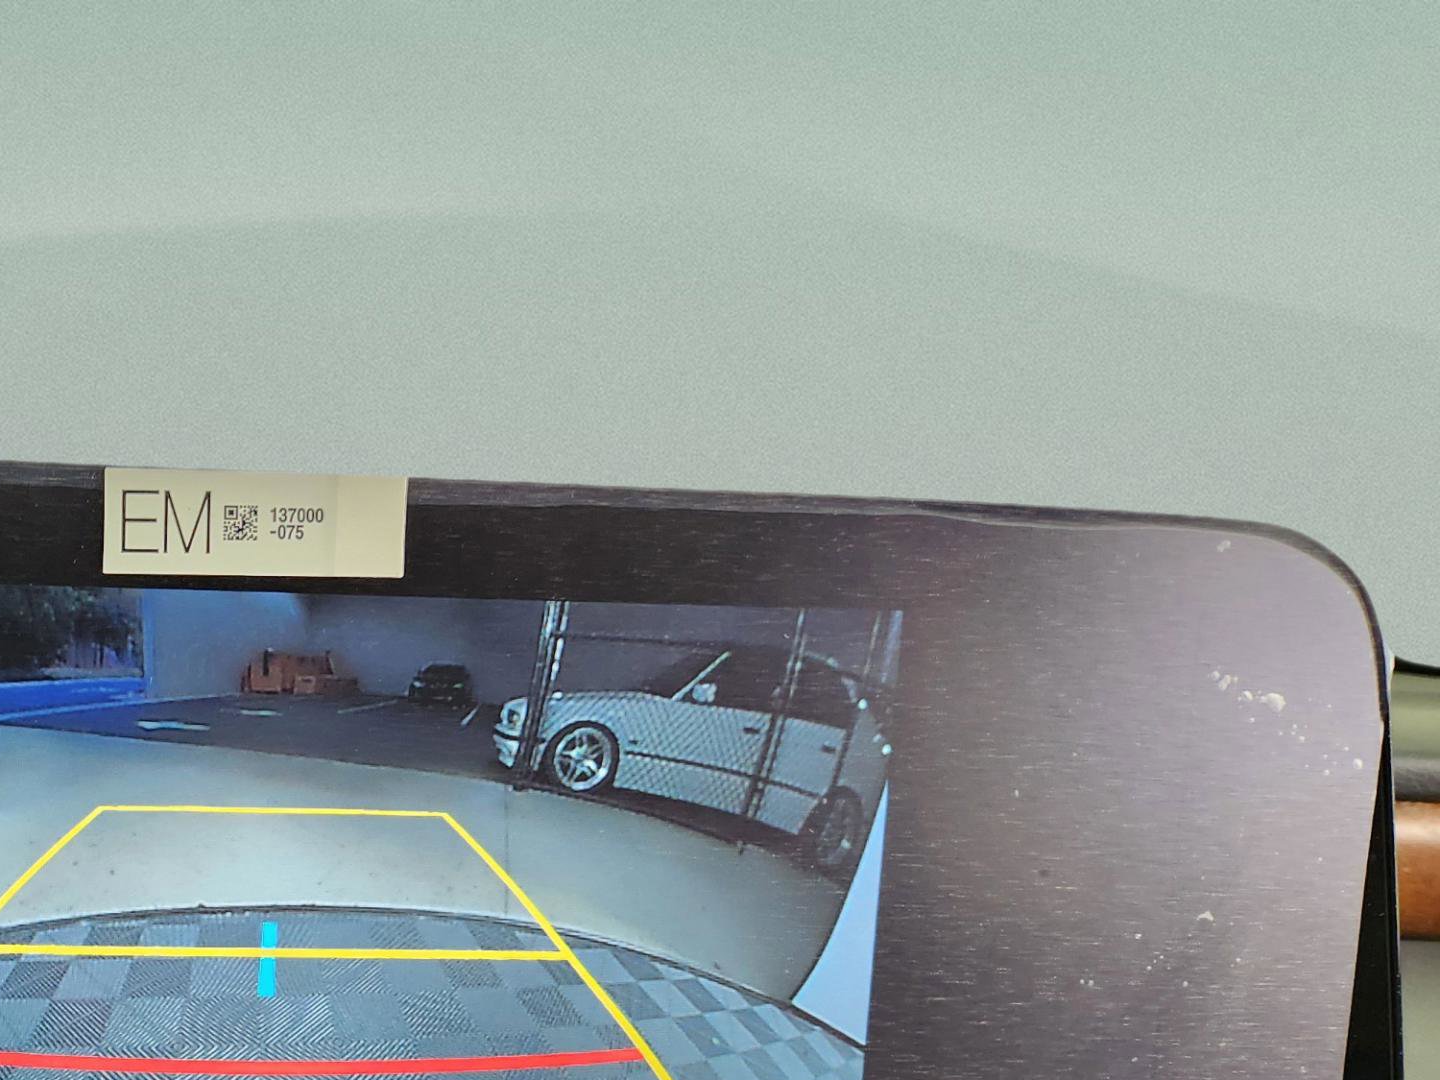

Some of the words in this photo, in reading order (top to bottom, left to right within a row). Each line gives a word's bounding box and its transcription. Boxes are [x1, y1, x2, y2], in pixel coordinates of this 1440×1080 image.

[120, 489, 212, 554] EM
[269, 506, 324, 523] 137000
[269, 524, 305, 541] -075
